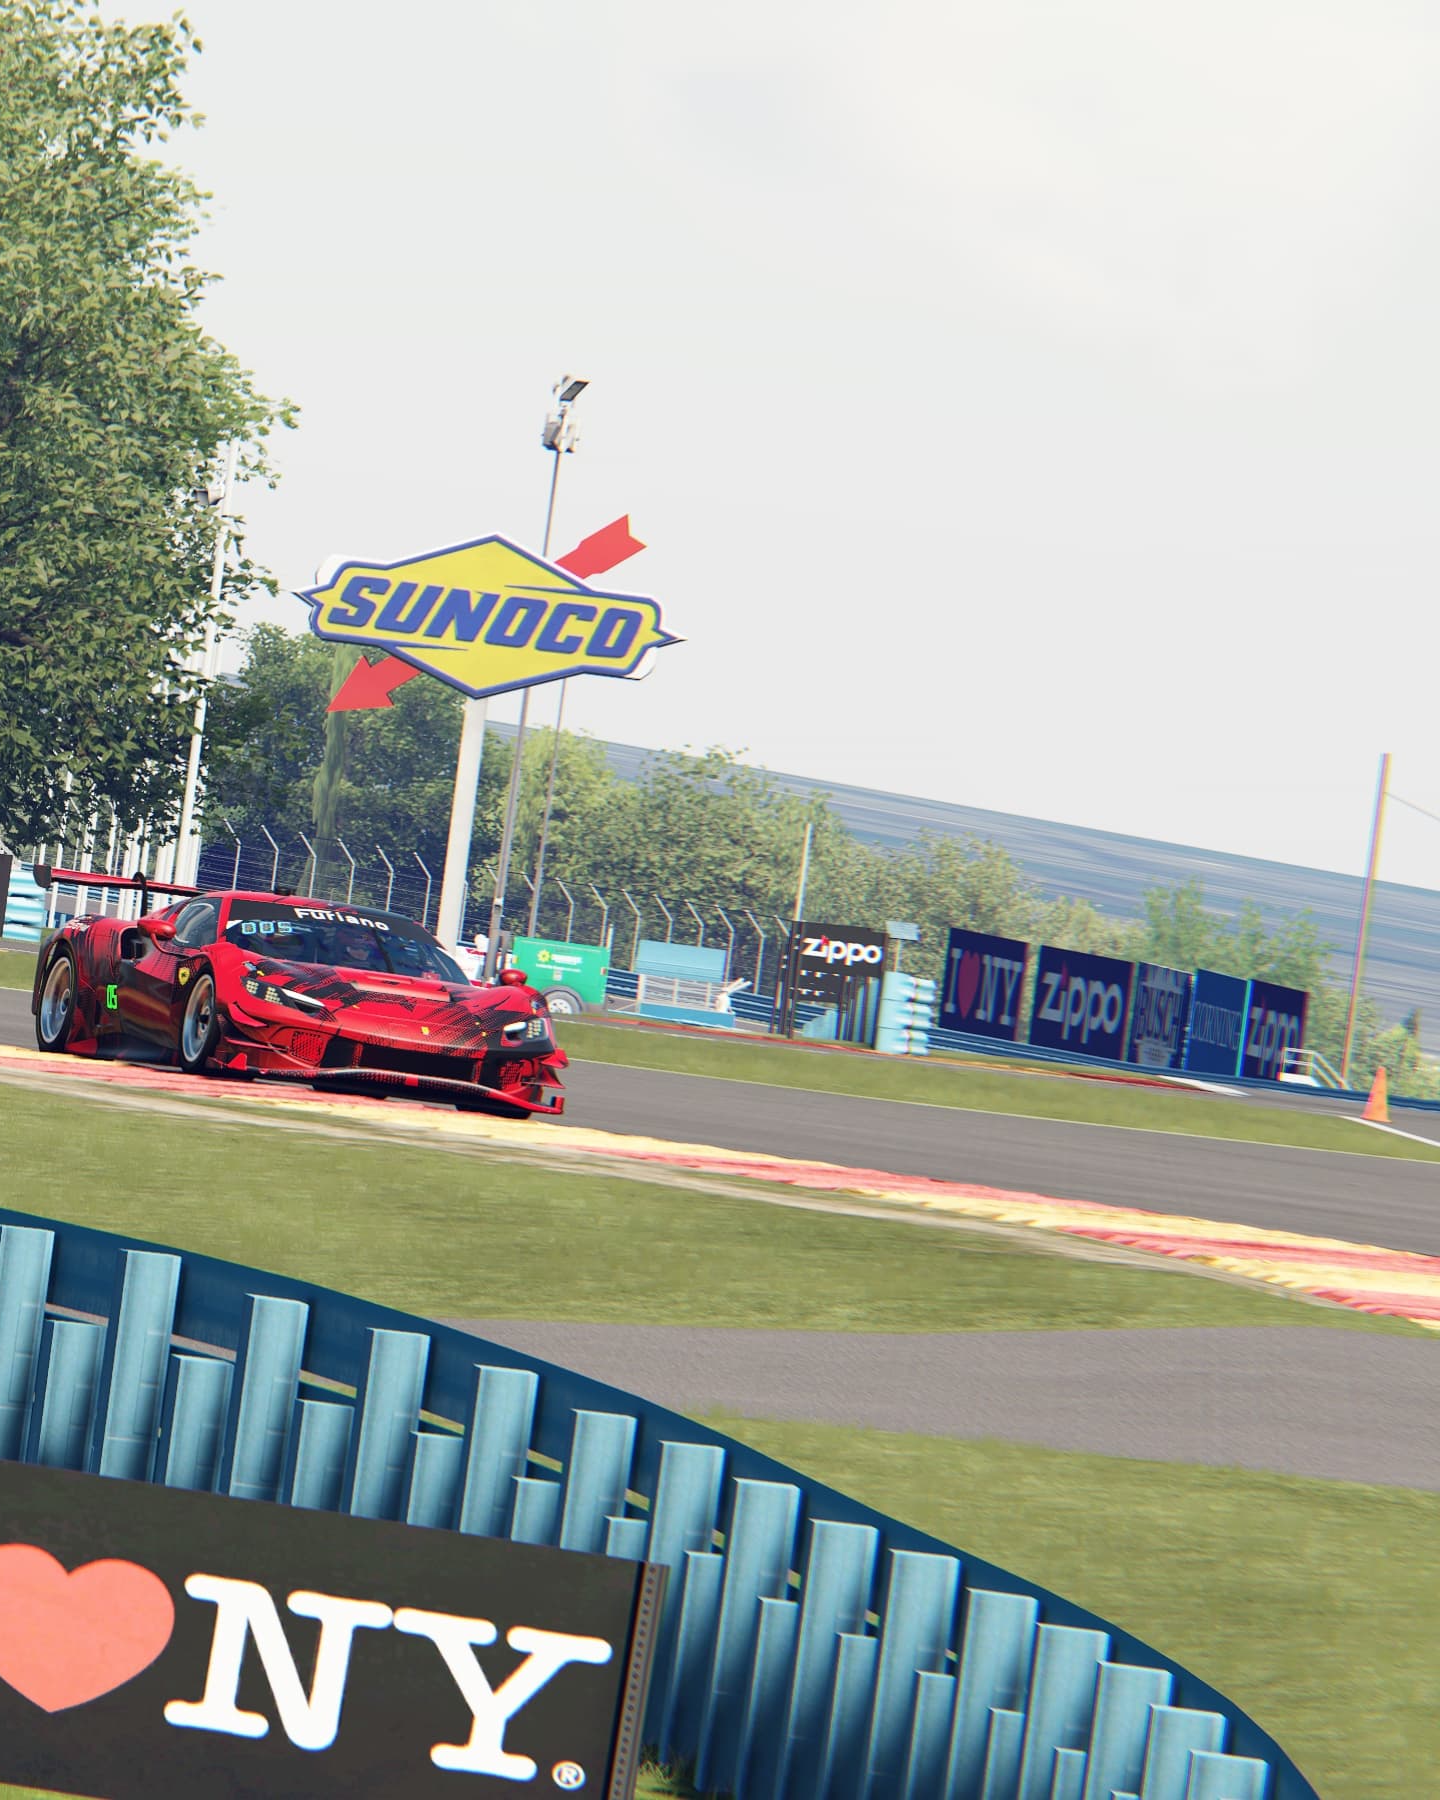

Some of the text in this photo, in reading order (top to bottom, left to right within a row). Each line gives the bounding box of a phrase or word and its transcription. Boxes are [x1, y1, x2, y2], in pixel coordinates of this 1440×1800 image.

[327, 575, 643, 659] SUNOCO
[294, 908, 390, 931] Furiano
[800, 934, 883, 966] zippo
[944, 948, 962, 1013] I
[1037, 960, 1123, 1044] zippo
